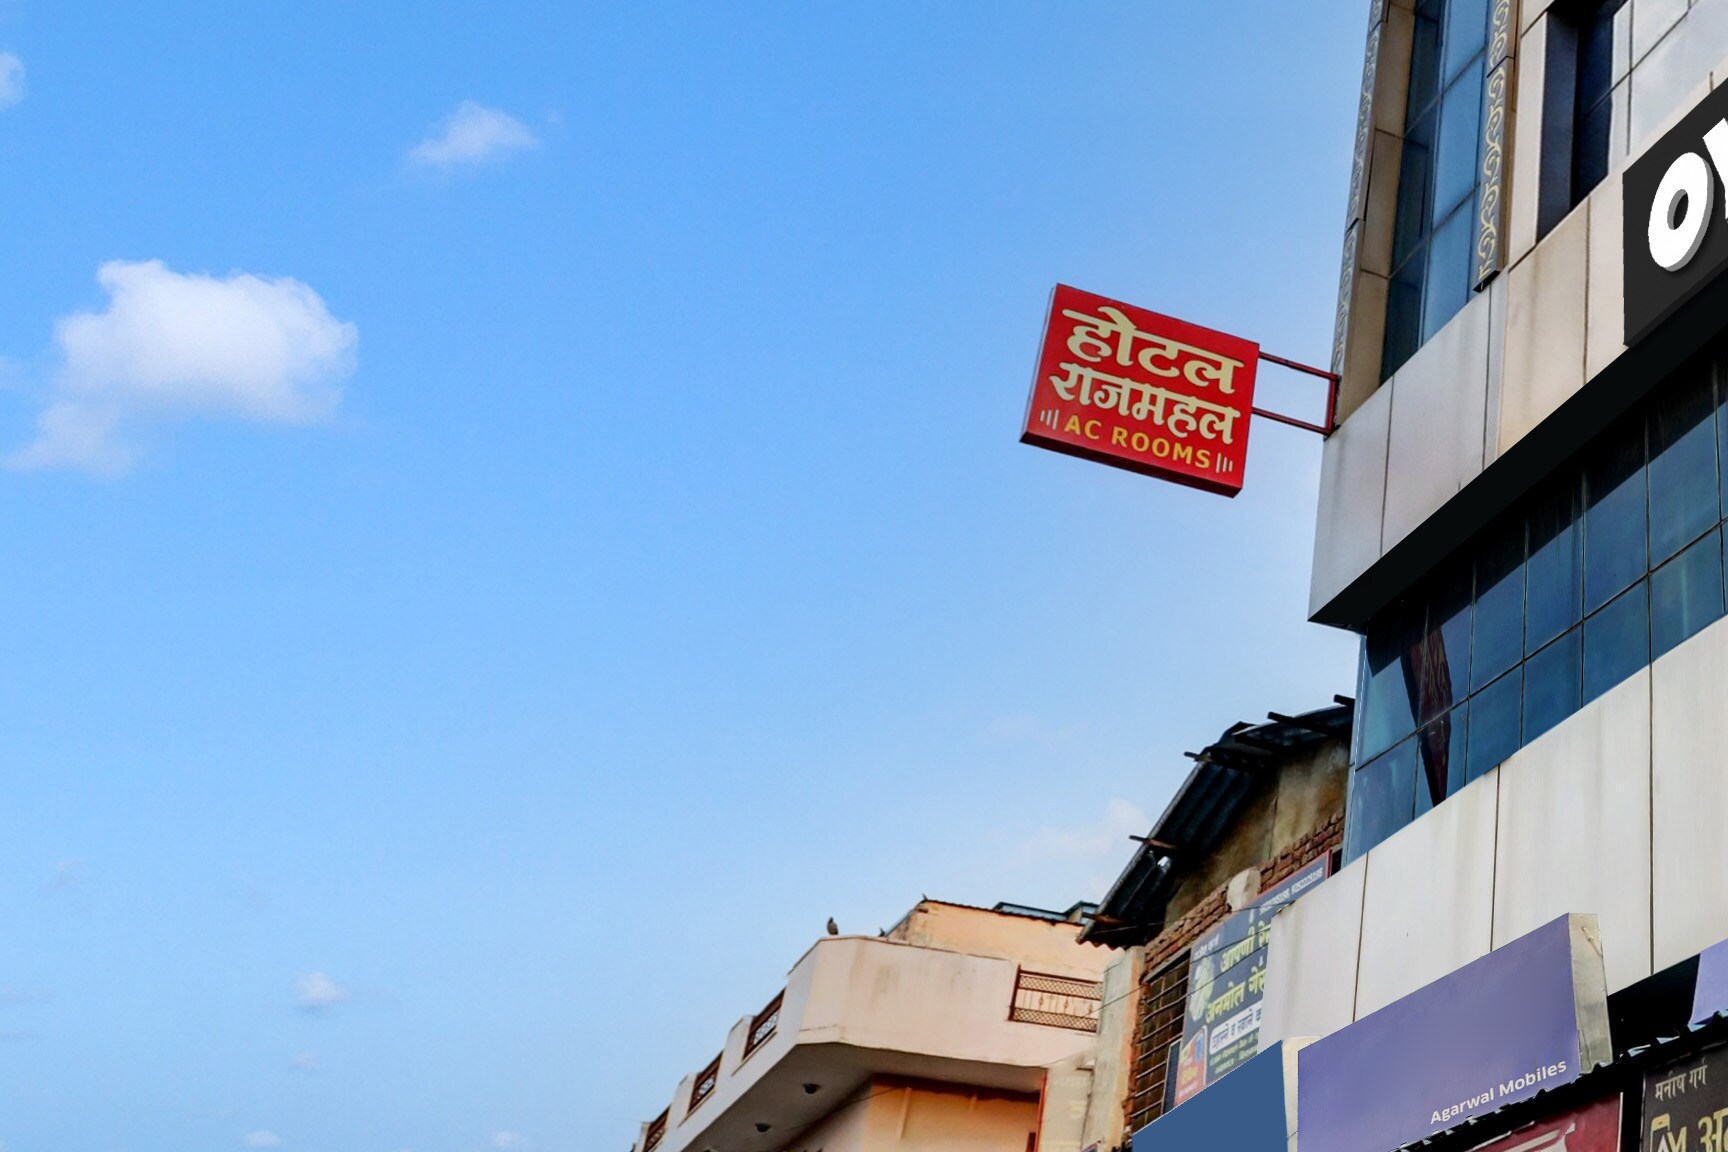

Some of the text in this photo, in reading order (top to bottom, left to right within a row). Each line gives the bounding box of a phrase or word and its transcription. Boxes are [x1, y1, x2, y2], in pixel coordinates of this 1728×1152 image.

[1062, 305, 1244, 394] होटल
[1049, 361, 1241, 445] राजमहल
[1064, 414, 1211, 469] AC ROOMS
[1430, 1060, 1567, 1125] Agarwal Mobiles
